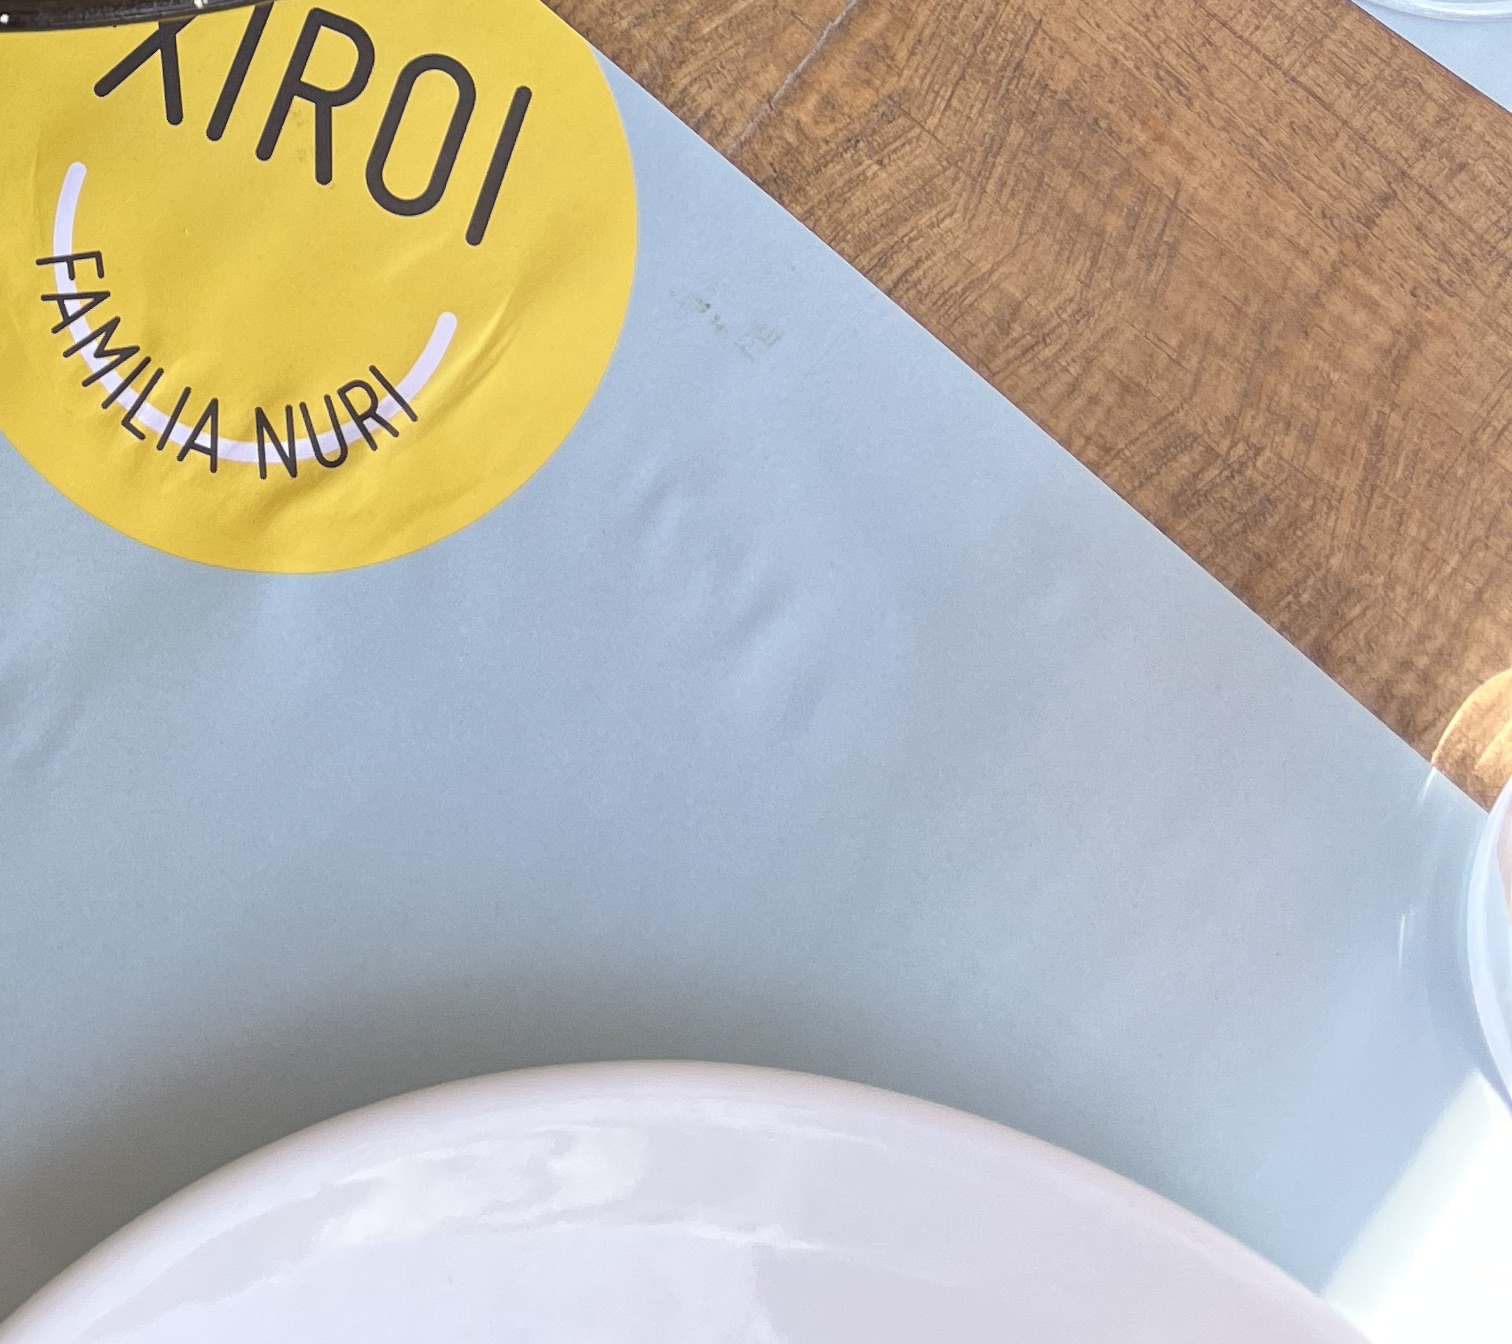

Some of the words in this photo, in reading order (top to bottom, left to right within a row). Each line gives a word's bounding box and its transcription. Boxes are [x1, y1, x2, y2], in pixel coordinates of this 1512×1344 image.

[93, 1, 532, 246] XIROI
[36, 250, 219, 473] FAMILIA
[254, 365, 418, 480] NURI
